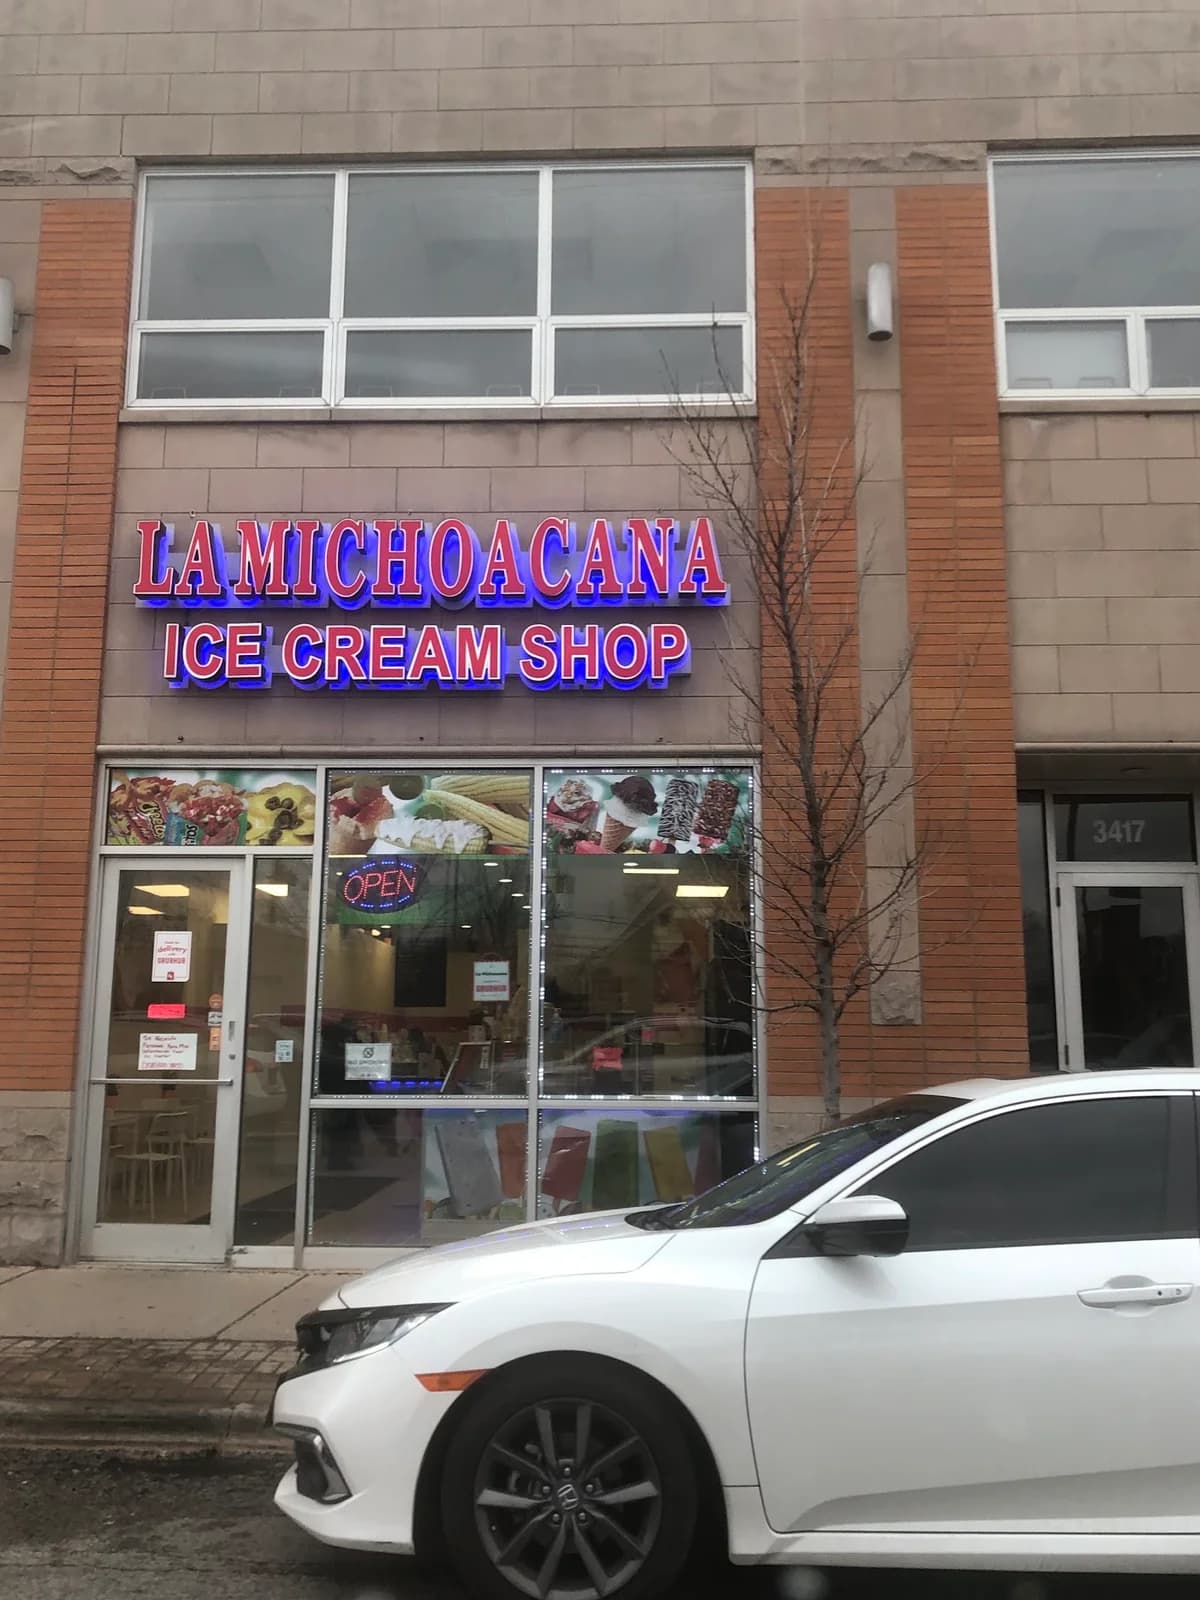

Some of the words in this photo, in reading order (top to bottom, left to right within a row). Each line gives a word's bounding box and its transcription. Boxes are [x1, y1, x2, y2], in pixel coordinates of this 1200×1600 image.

[133, 520, 223, 597] LA
[233, 517, 728, 599] MICHOACANA
[164, 623, 264, 680] ICE
[282, 623, 502, 681] CREAM
[519, 623, 689, 682] SHOP
[1092, 819, 1145, 843] 3417
[343, 866, 418, 902] OPEN
